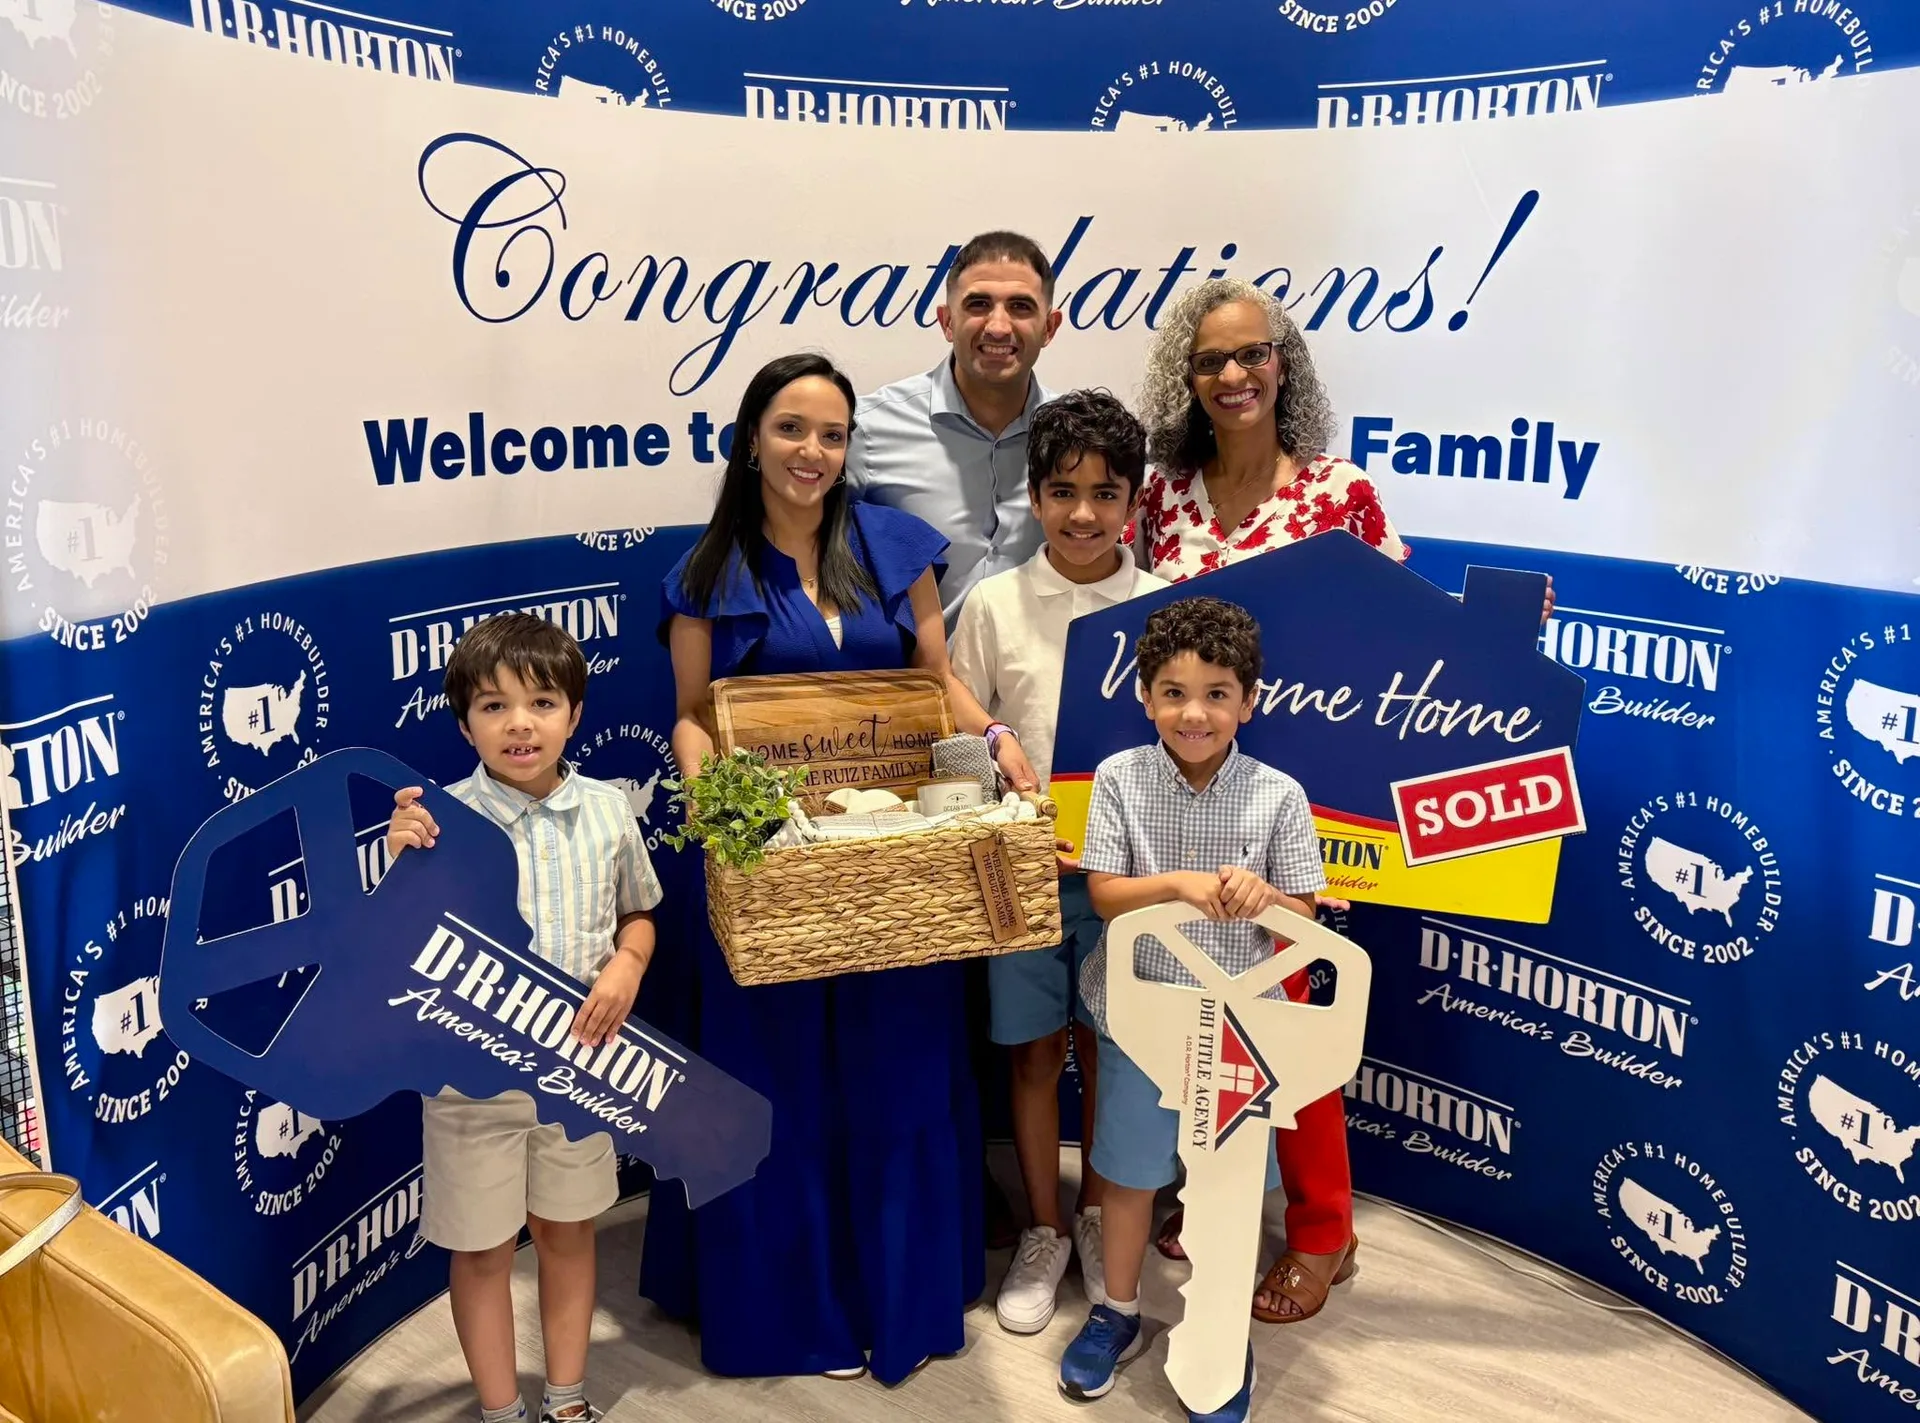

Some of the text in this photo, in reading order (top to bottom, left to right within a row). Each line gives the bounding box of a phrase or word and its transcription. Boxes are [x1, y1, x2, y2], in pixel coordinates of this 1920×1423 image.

[711, 0, 808, 21] NCE 200
[1279, 0, 1339, 33] SINCE
[536, 23, 671, 107] RICA'S #1 HOMEBUIL
[1696, 0, 1873, 94] RICA'S #1 HOMEBUIL
[0, 70, 46, 118] NCE
[1090, 61, 1238, 132] RICA'S #1 HOMEBUIL
[363, 411, 671, 486] Welcome
[1351, 416, 1600, 500] Family
[6, 438, 46, 592] AMERICA'S
[50, 419, 71, 450] #1
[576, 527, 655, 551] NCE 200
[1675, 564, 1781, 595] NCE 200
[39, 584, 158, 651] SINCE 2002
[1537, 618, 1723, 692] HORTON
[1817, 623, 1911, 740] AMERICA'S #1
[199, 612, 329, 768] AMERICA'S #1 HOMEBUILDER
[248, 695, 275, 735] #1
[1375, 658, 1543, 743] Home
[1588, 686, 1716, 729] Builder
[595, 727, 613, 748] #1
[802, 713, 892, 762] sweet
[892, 731, 940, 750] HOME
[1881, 705, 1919, 745] #1
[823, 767, 861, 785] RUIZ
[863, 761, 919, 781] FAMILY
[1413, 773, 1566, 838] SOLD
[1832, 758, 1905, 817] SINCE
[991, 849, 1010, 899] WELCOME
[1618, 795, 1669, 889] AMERICA'S
[1675, 791, 1698, 809] #1
[1706, 796, 1781, 933] HOMEBUILDER
[1675, 862, 1707, 899] #1
[1633, 905, 1755, 964] SINCE 2002
[62, 911, 128, 1091] AMERICA'S #1
[120, 990, 150, 1037] #1
[388, 987, 648, 1135] America's Builder
[1417, 983, 1683, 1090] America's Builder
[95, 1049, 190, 1124] SINCE 200
[1192, 997, 1216, 1151] DHI TITLE AGENCY
[1777, 1031, 1834, 1128] AMERICA'S
[1840, 1030, 1863, 1050] #1
[234, 1089, 257, 1192] AMERICA
[1343, 1065, 1513, 1156] HORTON
[1840, 1108, 1874, 1150] #1
[255, 1134, 342, 1216] SINCE 2002
[1402, 1130, 1513, 1182] Builder
[1795, 1147, 1862, 1213] SINCE
[1593, 1141, 1748, 1289] AMERICA'S #1 HOMEBUILDER
[1646, 1208, 1677, 1244] #1
[1610, 1235, 1725, 1305] SINCE 2002
[290, 1248, 400, 1365] America's
